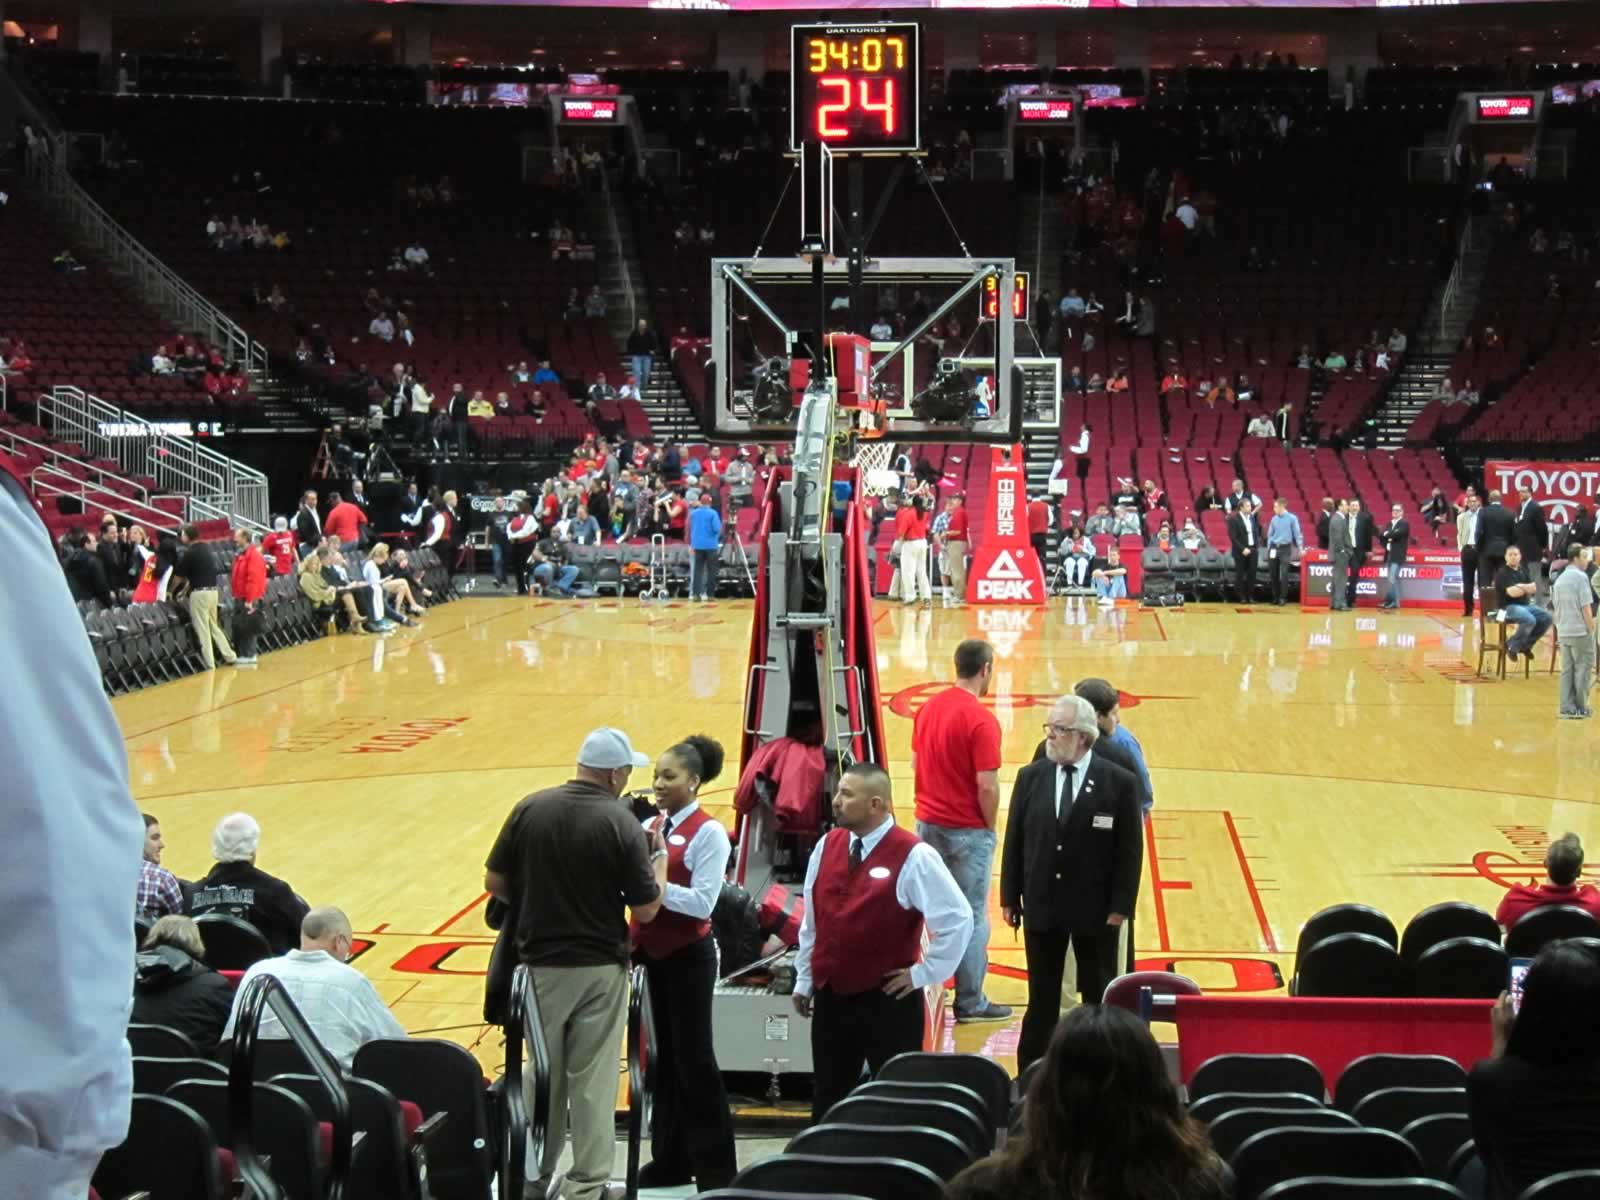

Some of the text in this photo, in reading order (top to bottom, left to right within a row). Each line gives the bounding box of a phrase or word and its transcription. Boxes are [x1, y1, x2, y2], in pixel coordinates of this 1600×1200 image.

[809, 39, 904, 72] 34:07
[818, 78, 894, 137] 24
[976, 579, 1035, 600] PEAK
